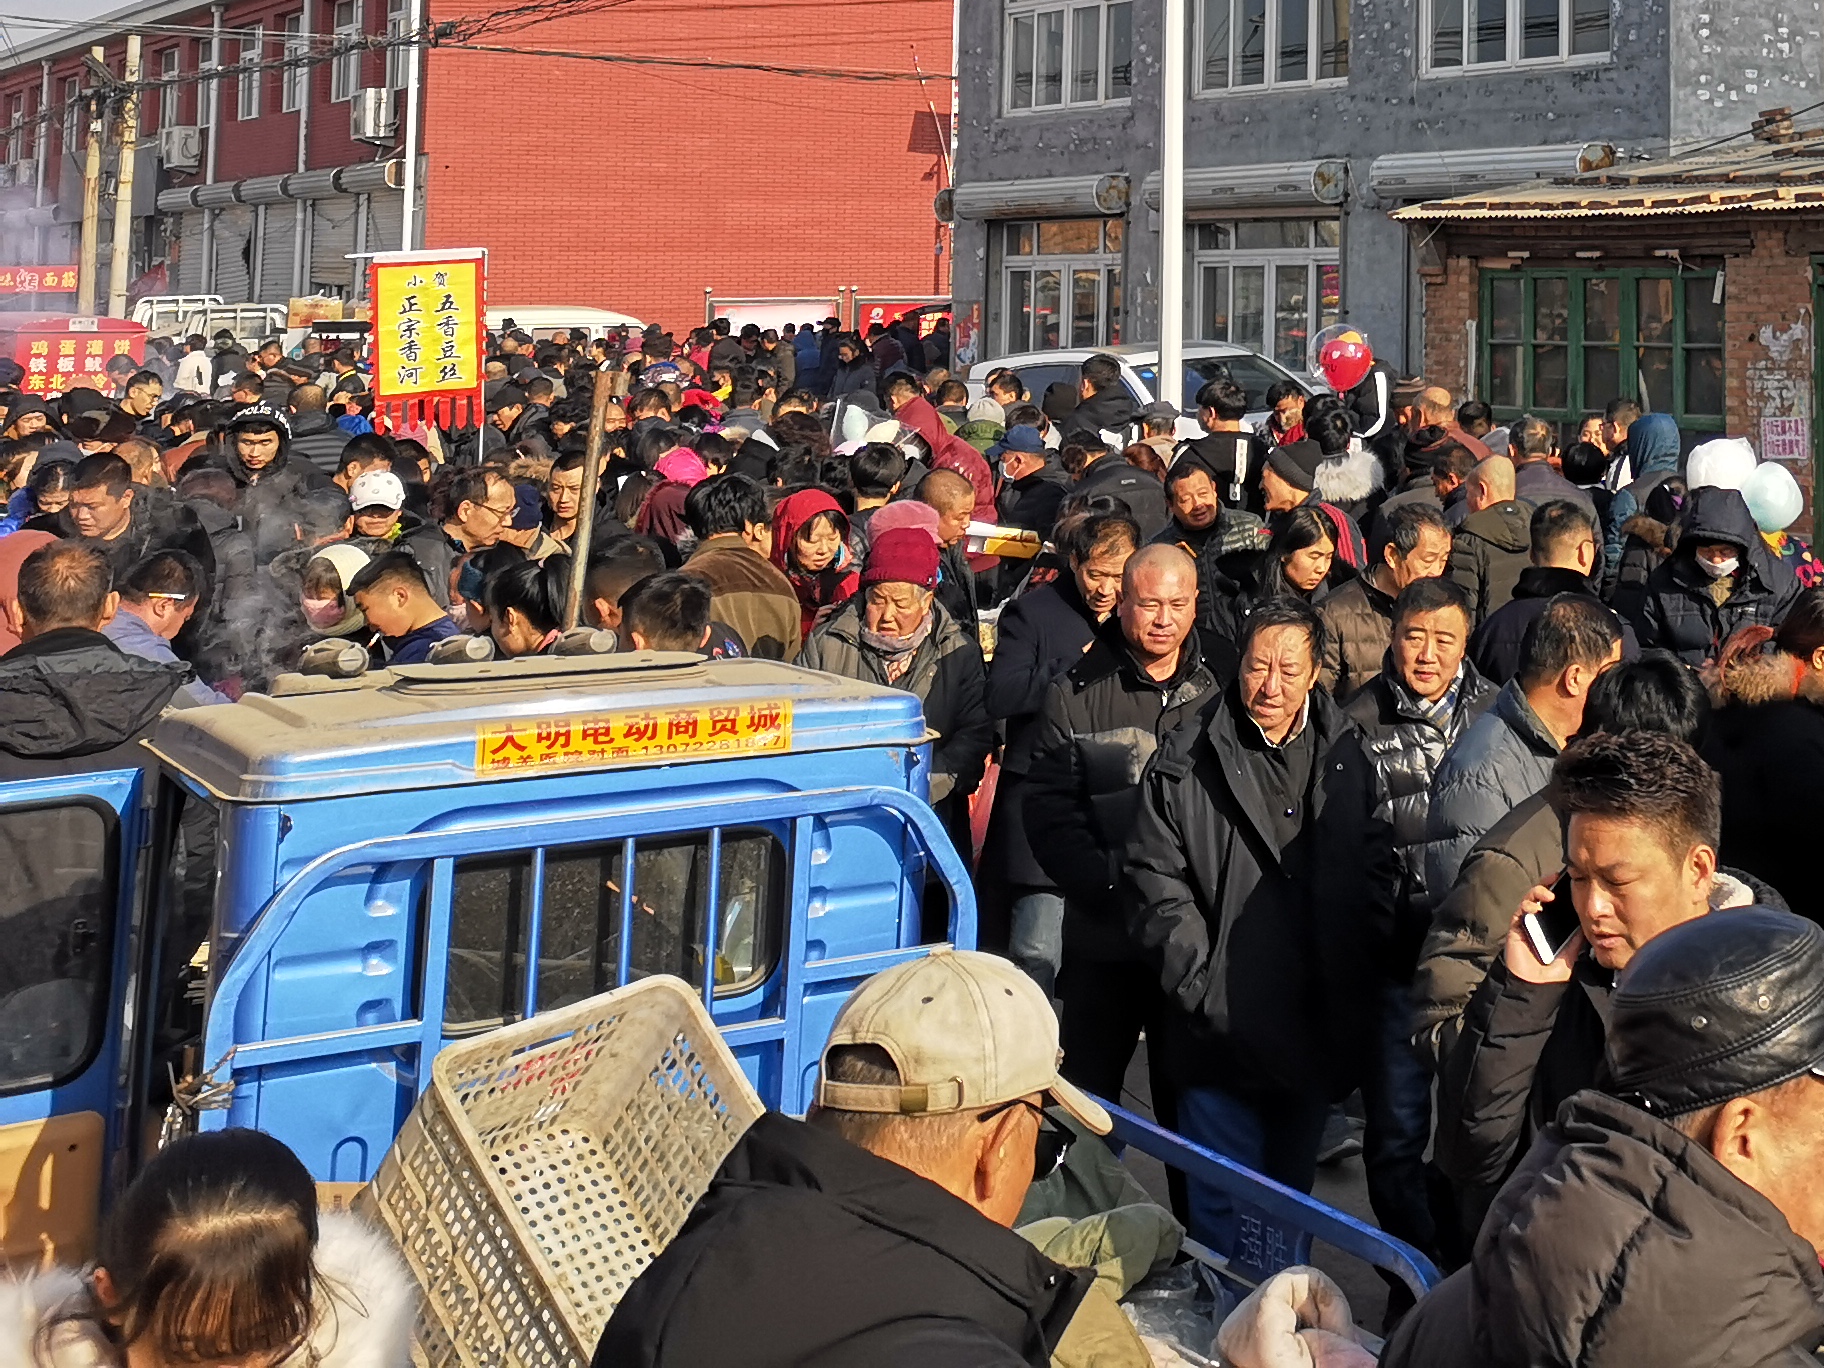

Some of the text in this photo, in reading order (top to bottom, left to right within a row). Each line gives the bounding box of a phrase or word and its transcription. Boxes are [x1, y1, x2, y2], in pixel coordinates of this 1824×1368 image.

[30, 339, 131, 355] 鸡蛋灌饼
[397, 295, 423, 385] 正宗香河
[434, 293, 462, 383] 五香豆丝
[28, 373, 117, 390] 东北冷
[489, 702, 782, 755] 大明电动商贸城
